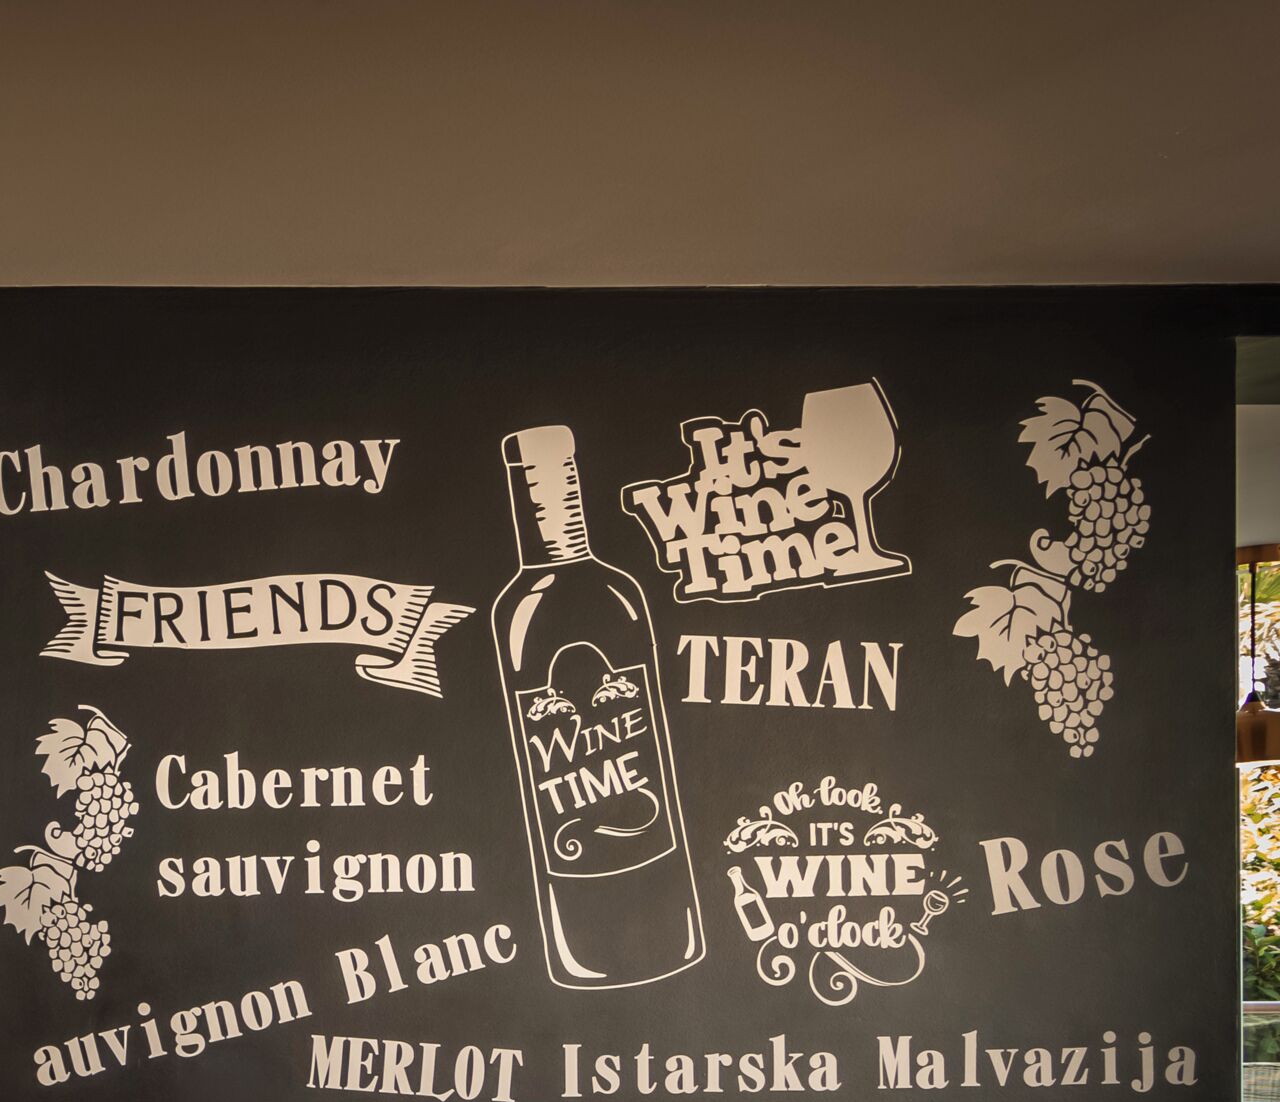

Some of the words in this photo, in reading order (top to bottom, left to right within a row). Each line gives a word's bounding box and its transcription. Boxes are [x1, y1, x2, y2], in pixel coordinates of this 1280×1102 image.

[632, 471, 830, 541] Wine
[666, 521, 857, 594] Time
[114, 580, 396, 645] FRIENDS
[677, 634, 904, 712] TERAN
[529, 708, 648, 773] WINE
[155, 751, 435, 810] Cabernet
[538, 751, 649, 815] TIME
[809, 822, 855, 846] IT'S
[157, 839, 475, 903] sauvignon
[753, 853, 926, 898] WINE
[979, 831, 1189, 916] Rose
[777, 905, 906, 949] o'clock
[34, 979, 312, 1088] auvignon
[335, 924, 517, 1005] Blanc
[306, 1034, 524, 1102] MERLOT
[561, 1033, 842, 1097] Istarska
[877, 1030, 1198, 1093] Malvazija
